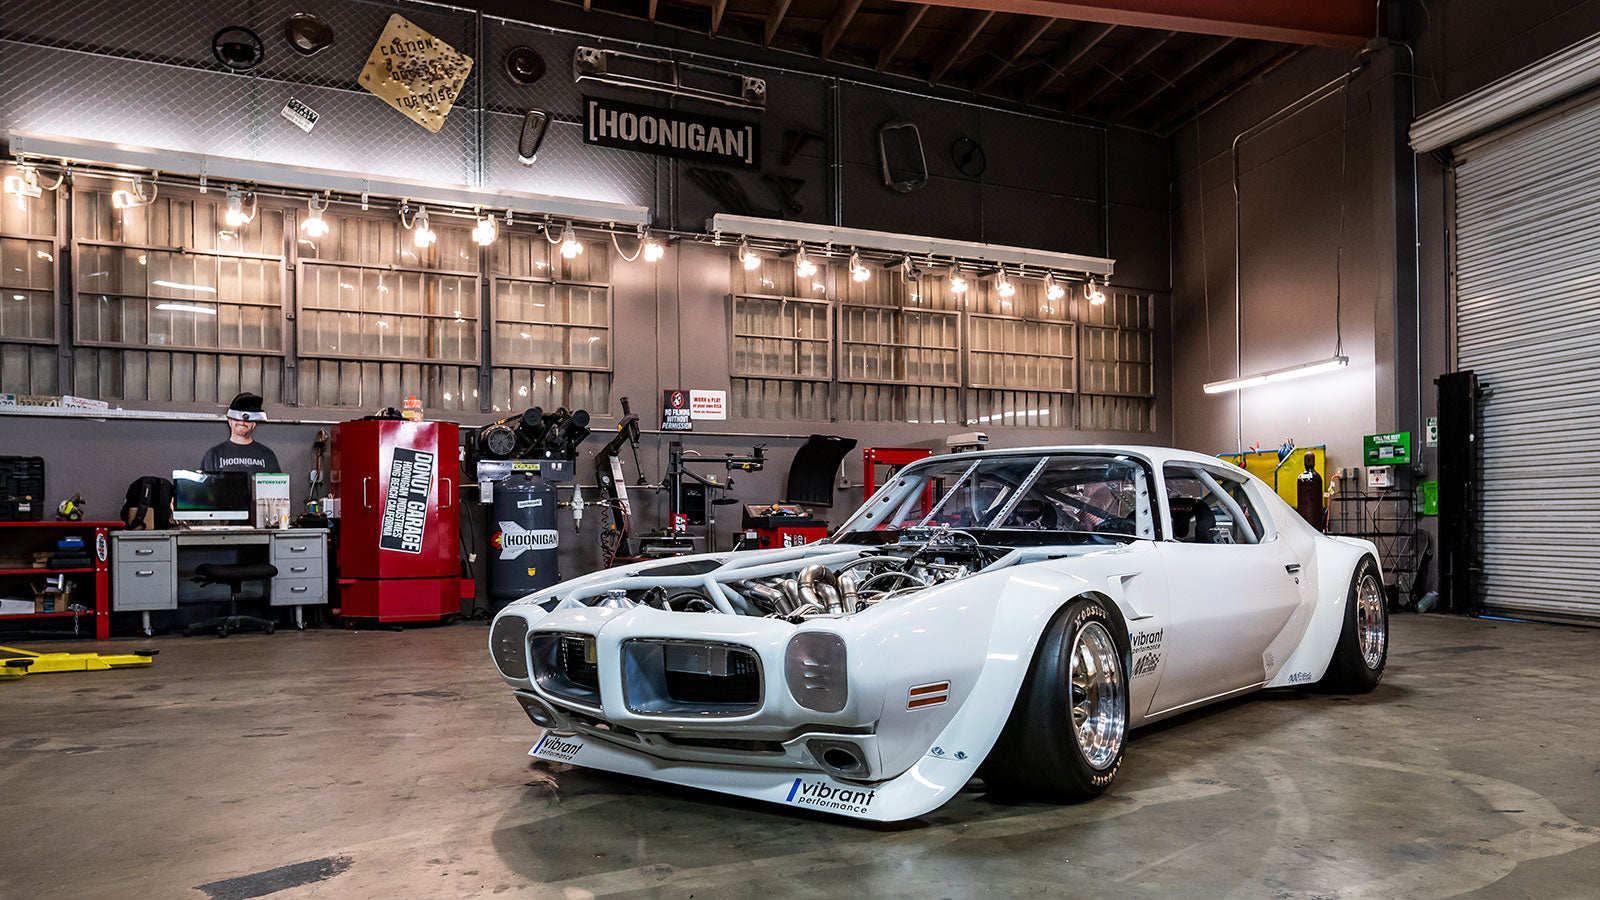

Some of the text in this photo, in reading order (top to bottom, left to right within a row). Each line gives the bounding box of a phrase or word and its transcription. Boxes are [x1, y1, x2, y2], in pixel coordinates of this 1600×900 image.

[381, 39, 433, 56] CAUTION
[395, 89, 454, 108] TORTOISE
[589, 100, 753, 164] [HOONIGAN]
[664, 408, 672, 416] NO
[672, 408, 690, 416] FILMING
[666, 415, 689, 423] WITHOUT
[661, 422, 692, 430] PERMISSION
[383, 460, 403, 536] LONG BEACH CALIFORNIA
[392, 460, 413, 538] HOONIGAN INDUSTRIES
[401, 453, 433, 551] DONUT GARAGE
[1132, 627, 1164, 646] vibrant
[538, 748, 573, 760] performance
[543, 737, 585, 755] vibrant
[802, 781, 875, 806] vibrant
[798, 796, 868, 814] performance
